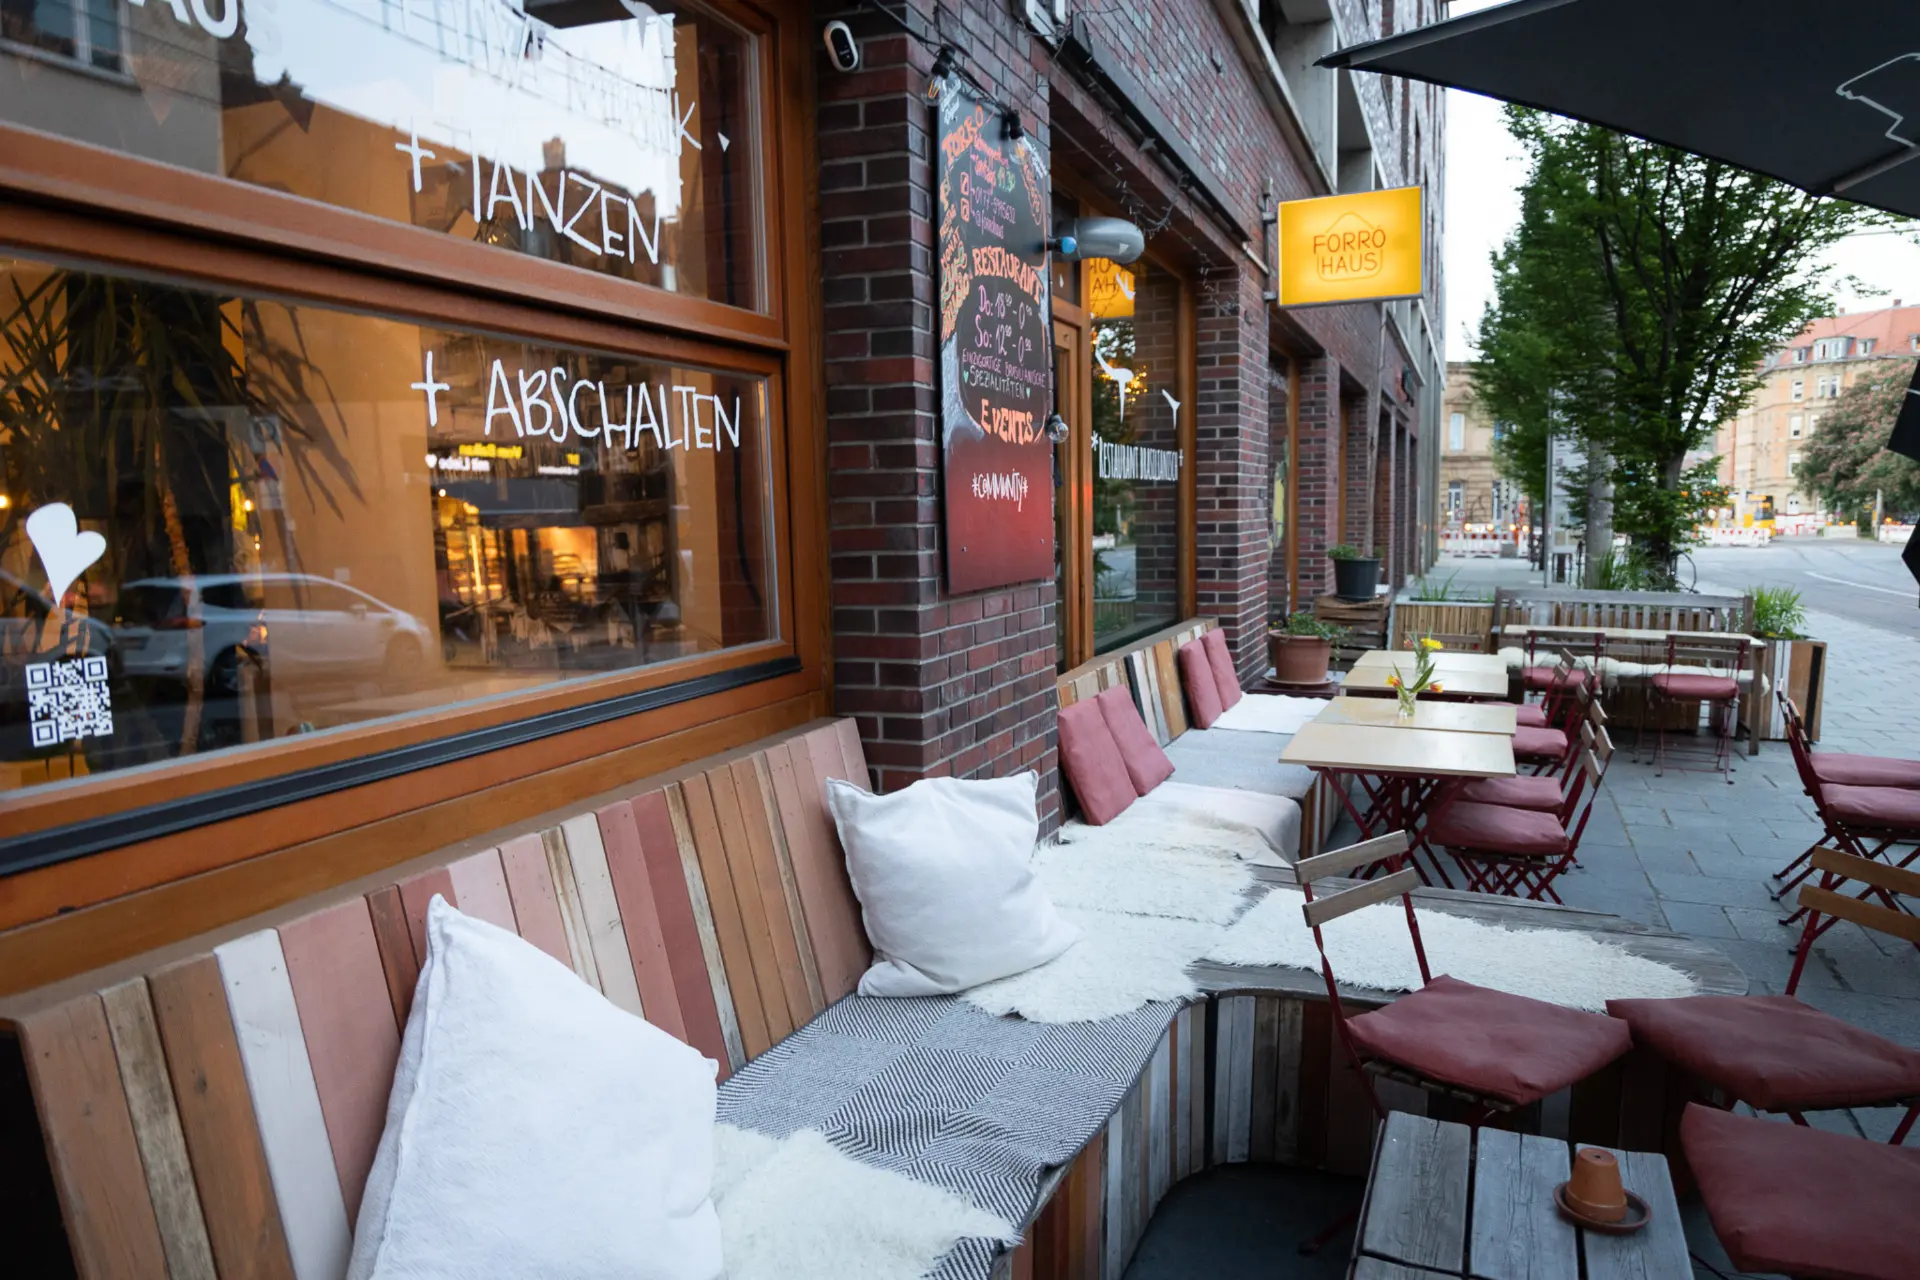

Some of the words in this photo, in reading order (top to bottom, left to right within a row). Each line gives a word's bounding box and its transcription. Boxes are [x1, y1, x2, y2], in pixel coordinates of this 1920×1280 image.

[434, 121, 661, 265] TANZEN
[972, 246, 1041, 305] RESTAURANT
[1321, 252, 1378, 274] HAUS
[975, 314, 992, 348] So:
[484, 358, 740, 452] ABSCHALTEN
[981, 398, 1034, 446] EVENTS
